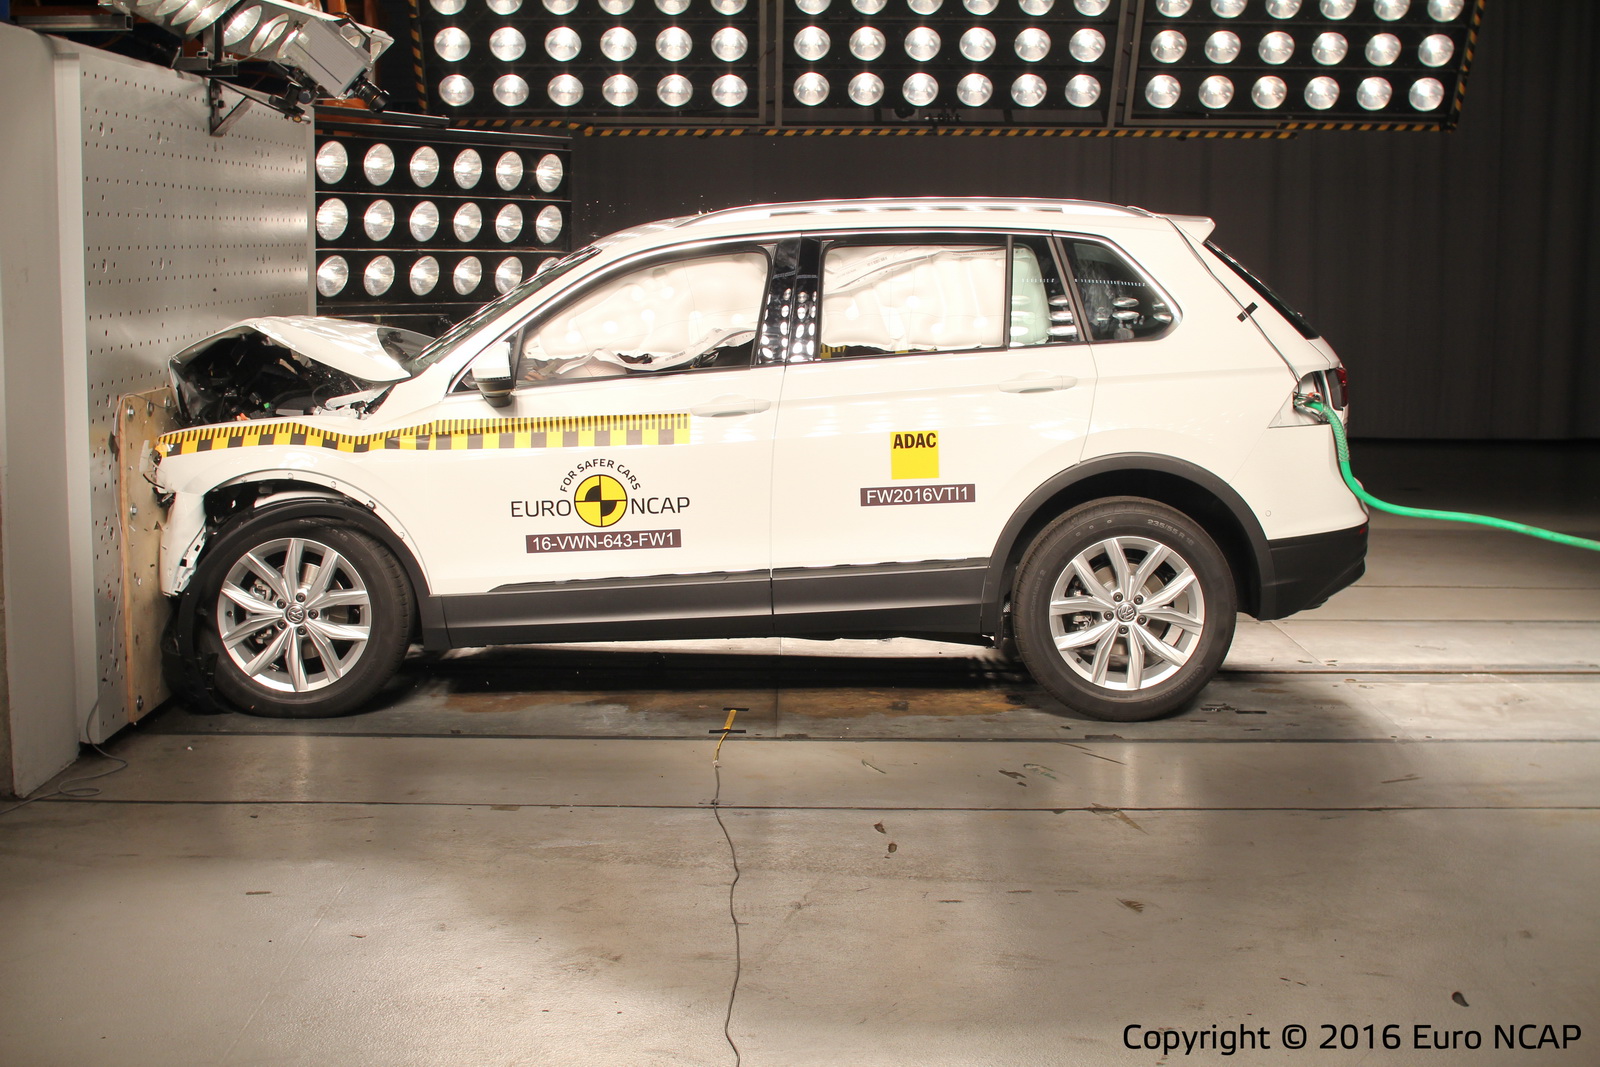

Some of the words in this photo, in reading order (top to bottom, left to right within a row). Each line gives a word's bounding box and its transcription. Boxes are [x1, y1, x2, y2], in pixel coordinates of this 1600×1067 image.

[893, 432, 937, 449] ADAC
[559, 470, 578, 492] FOR
[576, 458, 615, 473] SAFER
[616, 464, 641, 491] CARS
[866, 486, 968, 504] FW2016VTI1
[510, 499, 572, 517] EURO
[630, 496, 691, 515] NCAP
[532, 531, 674, 551] 16-VWN-643-FW1
